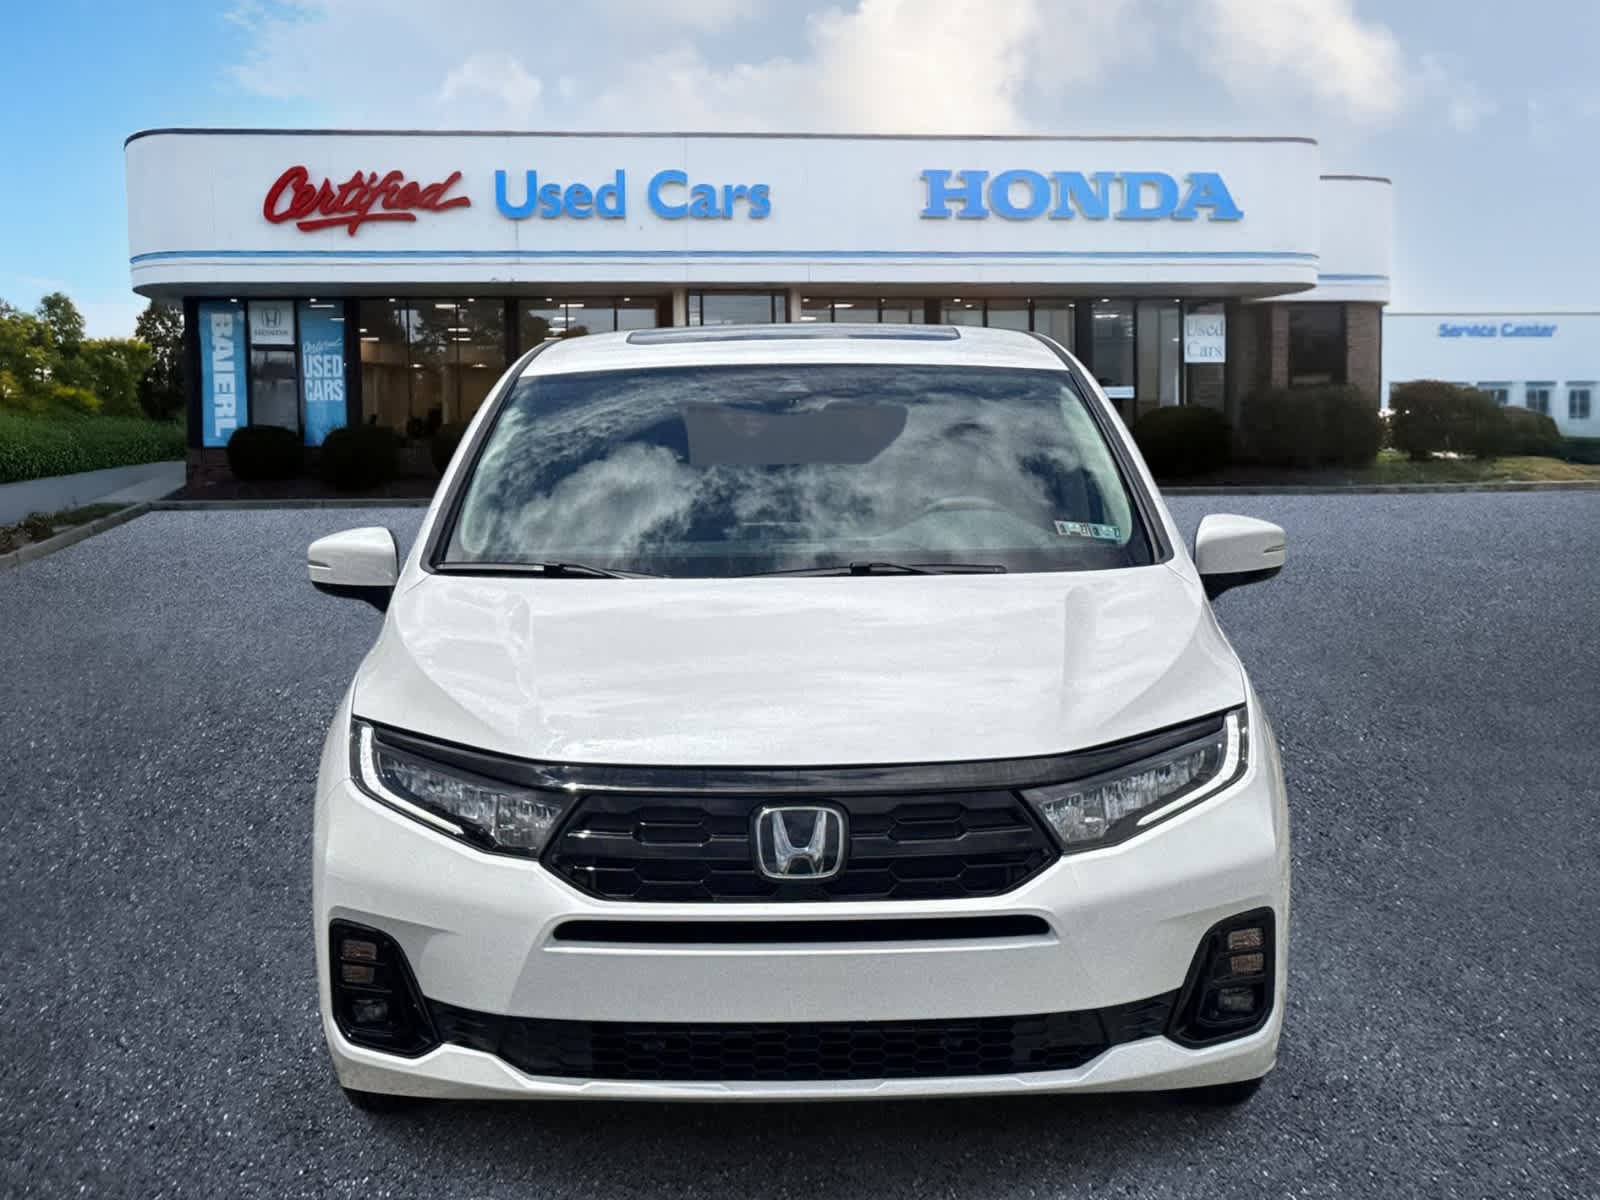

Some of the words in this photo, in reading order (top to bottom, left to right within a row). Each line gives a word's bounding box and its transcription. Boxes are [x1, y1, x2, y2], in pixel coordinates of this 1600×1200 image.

[263, 165, 472, 237] Certified
[494, 168, 626, 221] Used
[647, 168, 771, 221] Cars
[919, 169, 1245, 221] HONDA
[1186, 318, 1225, 337] Used
[1438, 323, 1497, 338] Service
[1187, 342, 1223, 358] Cars
[211, 313, 237, 437] BAIERL
[304, 354, 343, 378] USED
[305, 379, 344, 401] CARS
